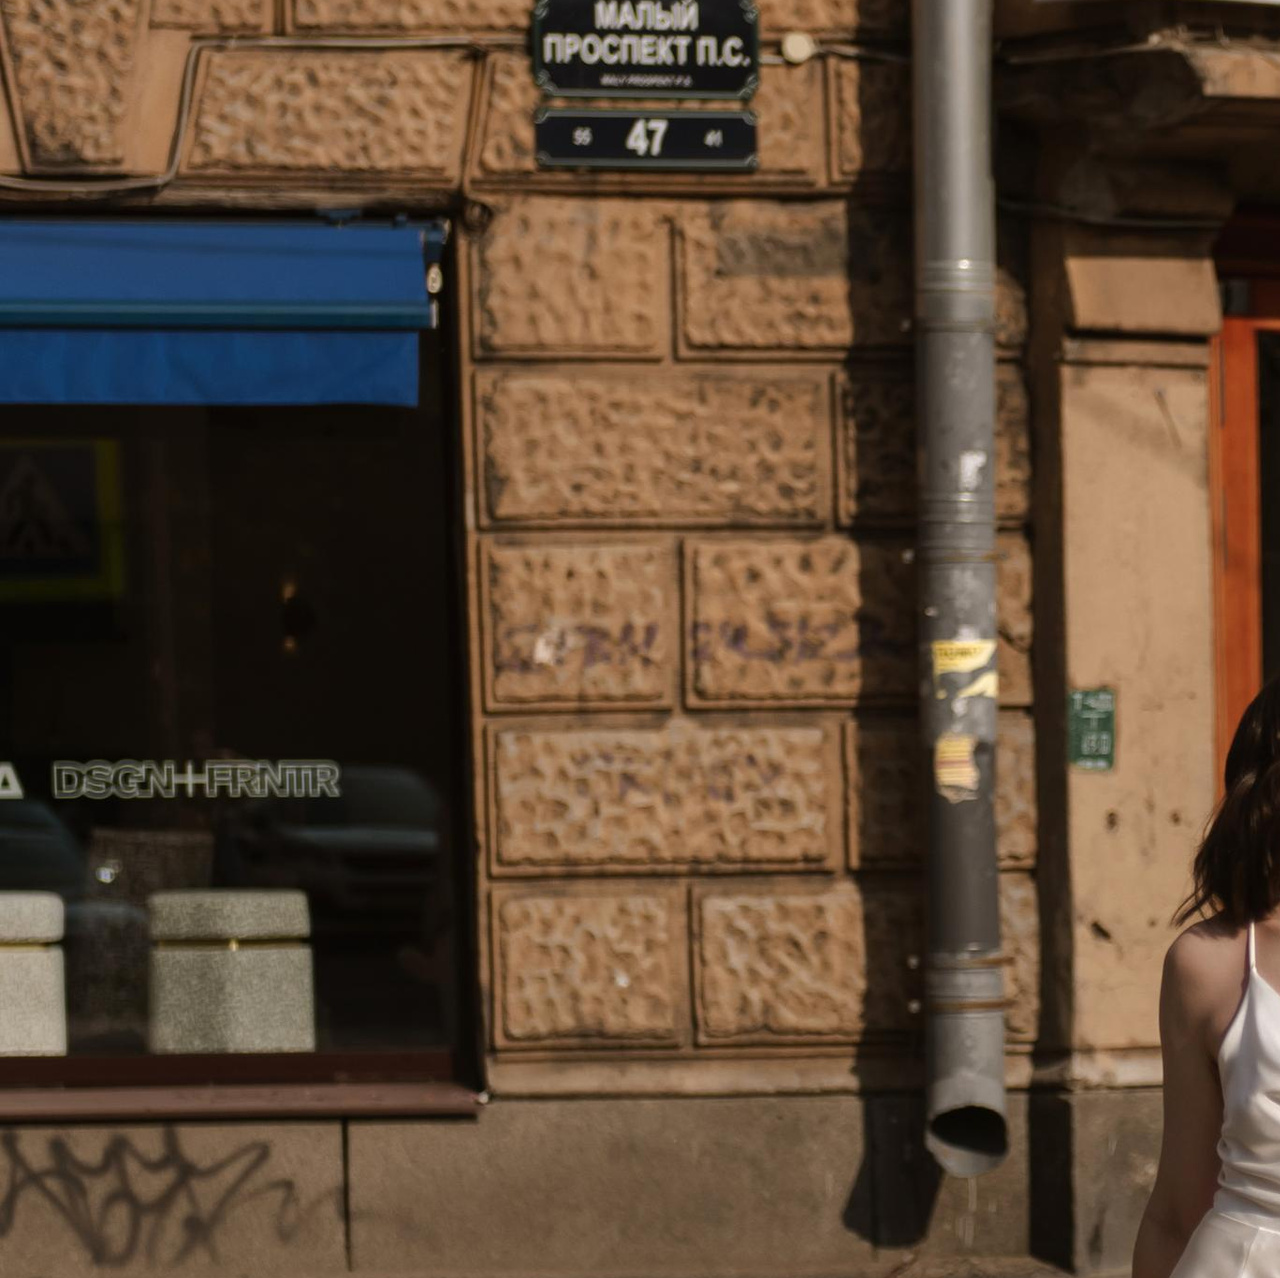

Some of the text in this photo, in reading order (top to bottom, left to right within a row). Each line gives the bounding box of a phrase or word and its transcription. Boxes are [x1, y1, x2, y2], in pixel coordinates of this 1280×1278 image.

[543, 32, 751, 67] ПРОСПЕКТ П.С.
[625, 119, 669, 156] 47
[53, 759, 341, 799] DSGN+FRNTR
